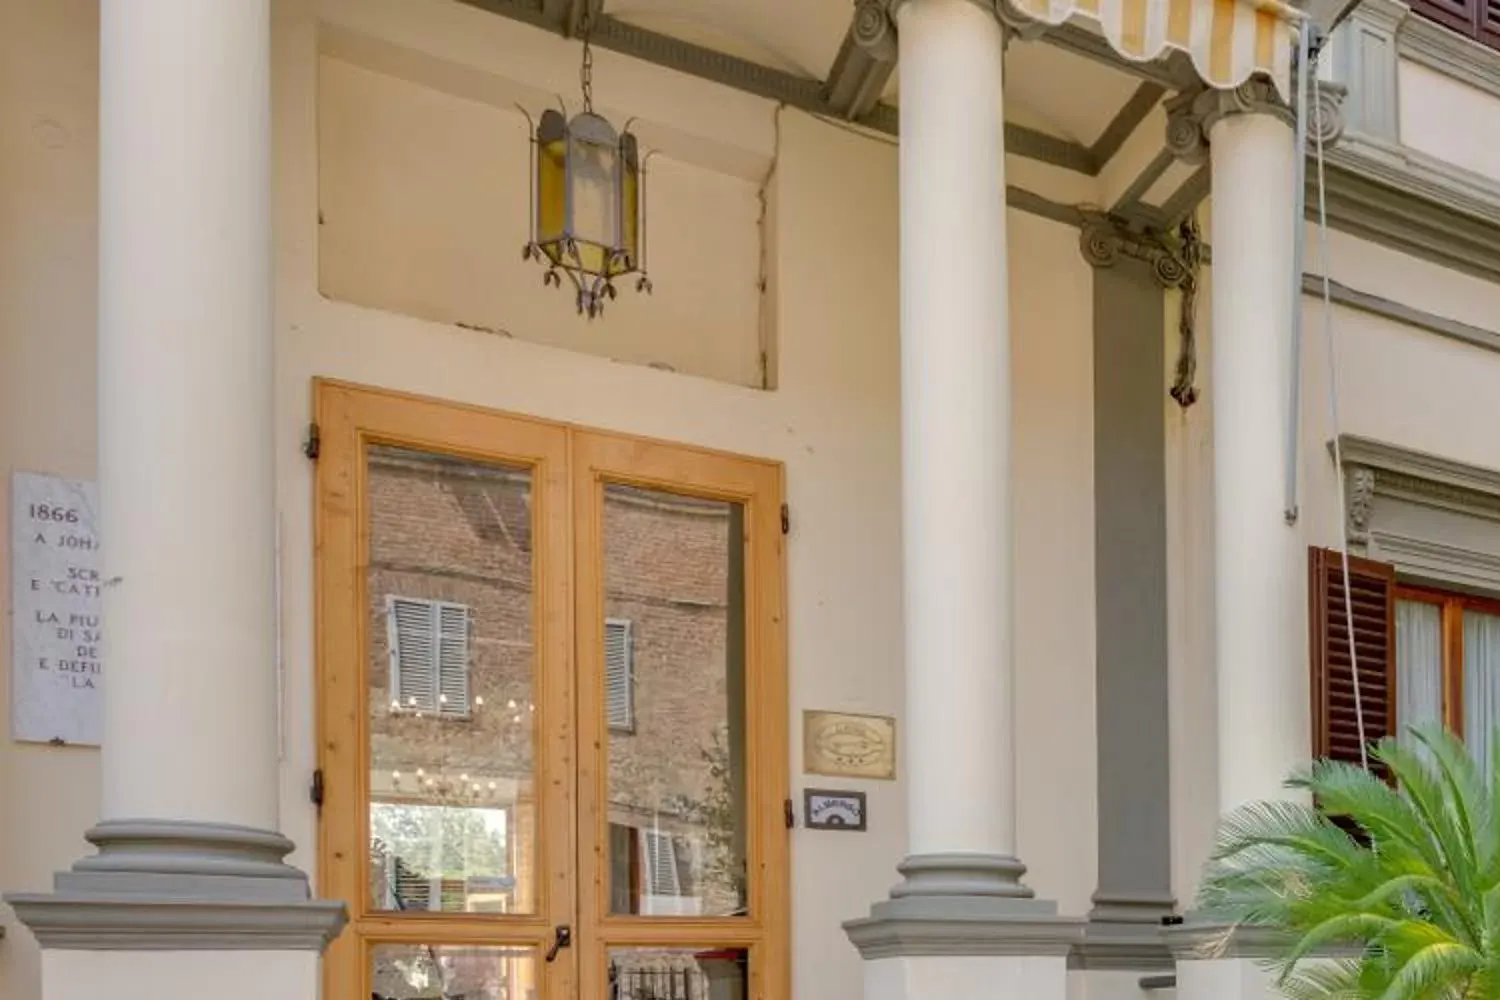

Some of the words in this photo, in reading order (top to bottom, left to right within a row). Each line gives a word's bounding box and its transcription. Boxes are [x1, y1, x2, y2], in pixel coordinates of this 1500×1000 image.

[29, 503, 79, 523] 1866
[34, 533, 47, 545] A
[31, 579, 41, 591] E
[36, 609, 60, 623] LA
[57, 627, 73, 640] DI
[77, 645, 97, 659] DE
[39, 657, 50, 670] E
